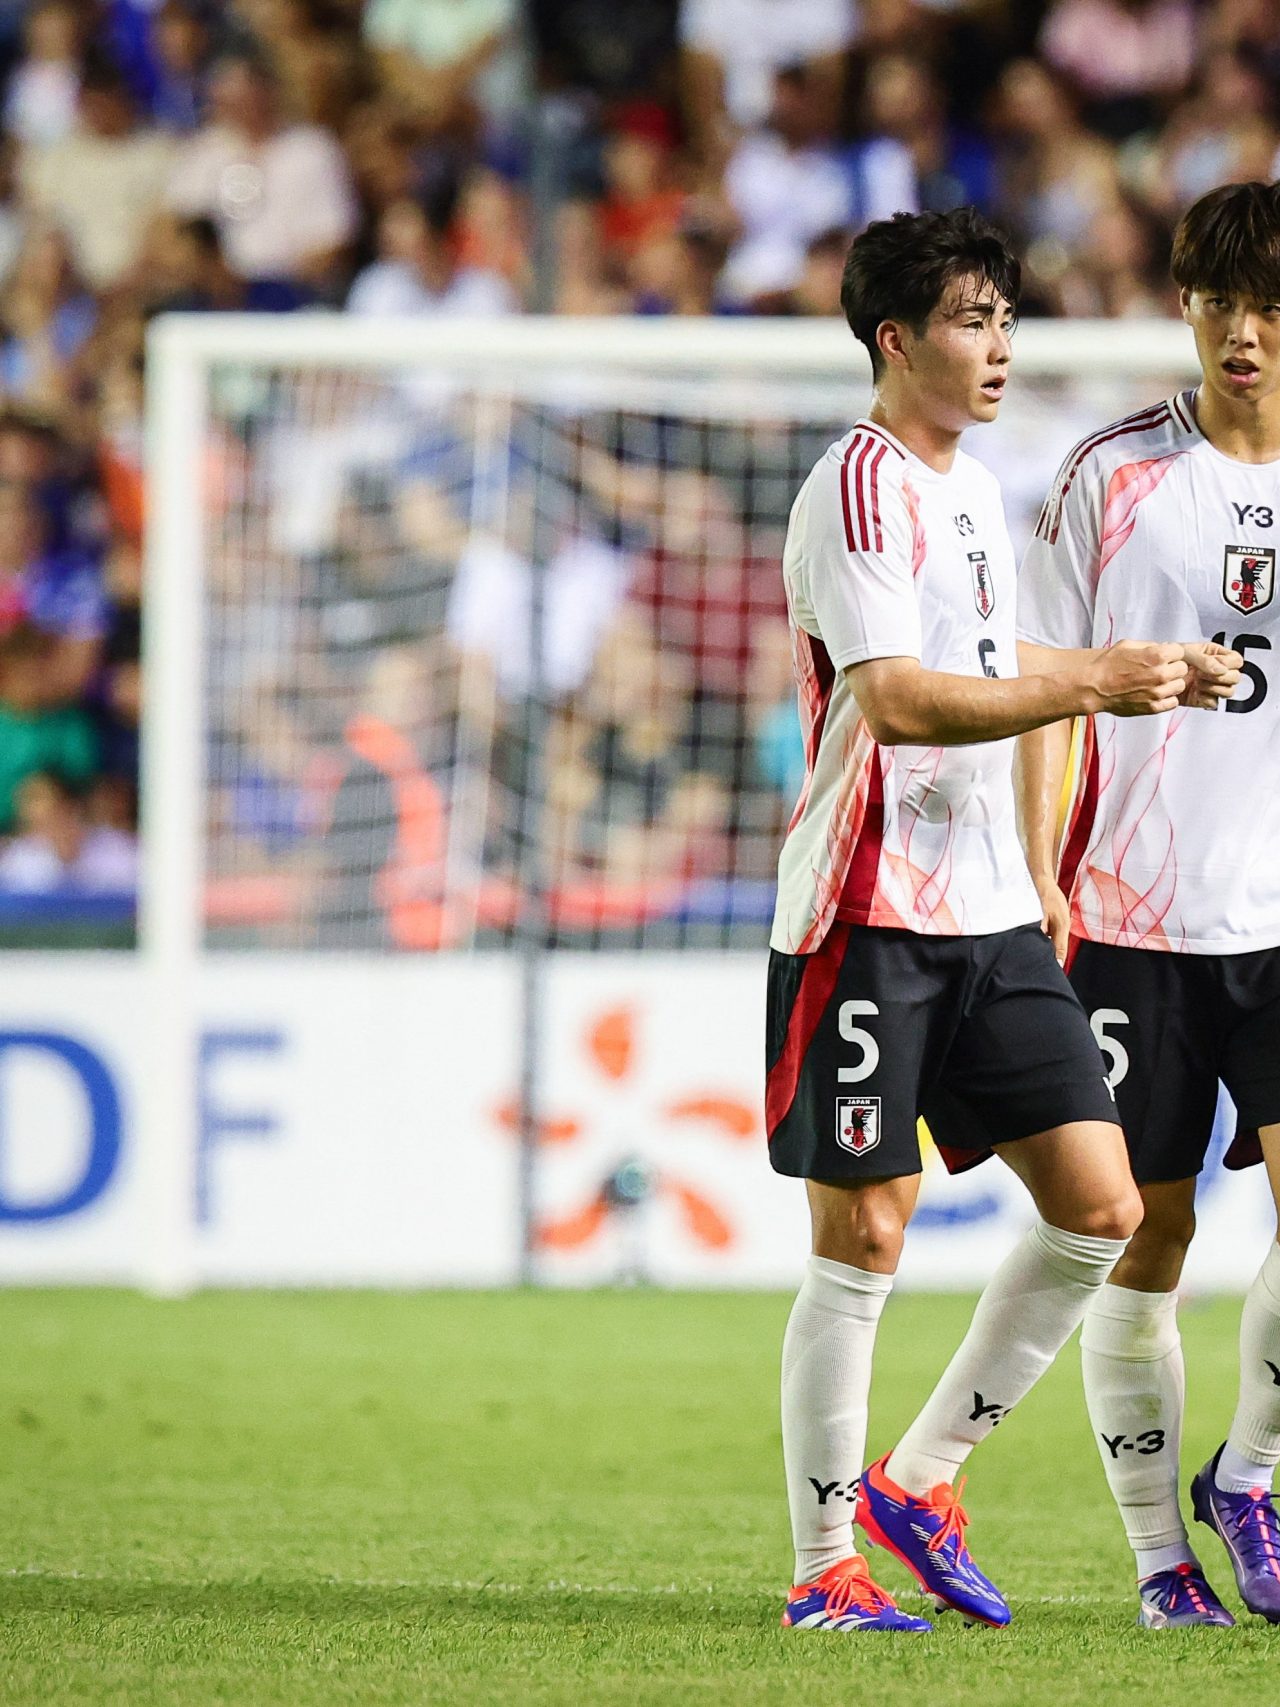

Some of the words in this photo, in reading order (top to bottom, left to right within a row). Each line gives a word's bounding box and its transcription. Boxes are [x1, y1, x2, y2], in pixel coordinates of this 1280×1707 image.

[1231, 502, 1274, 528] Y-3
[1236, 547, 1265, 556] JAPAN
[1211, 631, 1272, 714] 5
[838, 1000, 880, 1083] 5
[1101, 1429, 1165, 1459] Y-3
